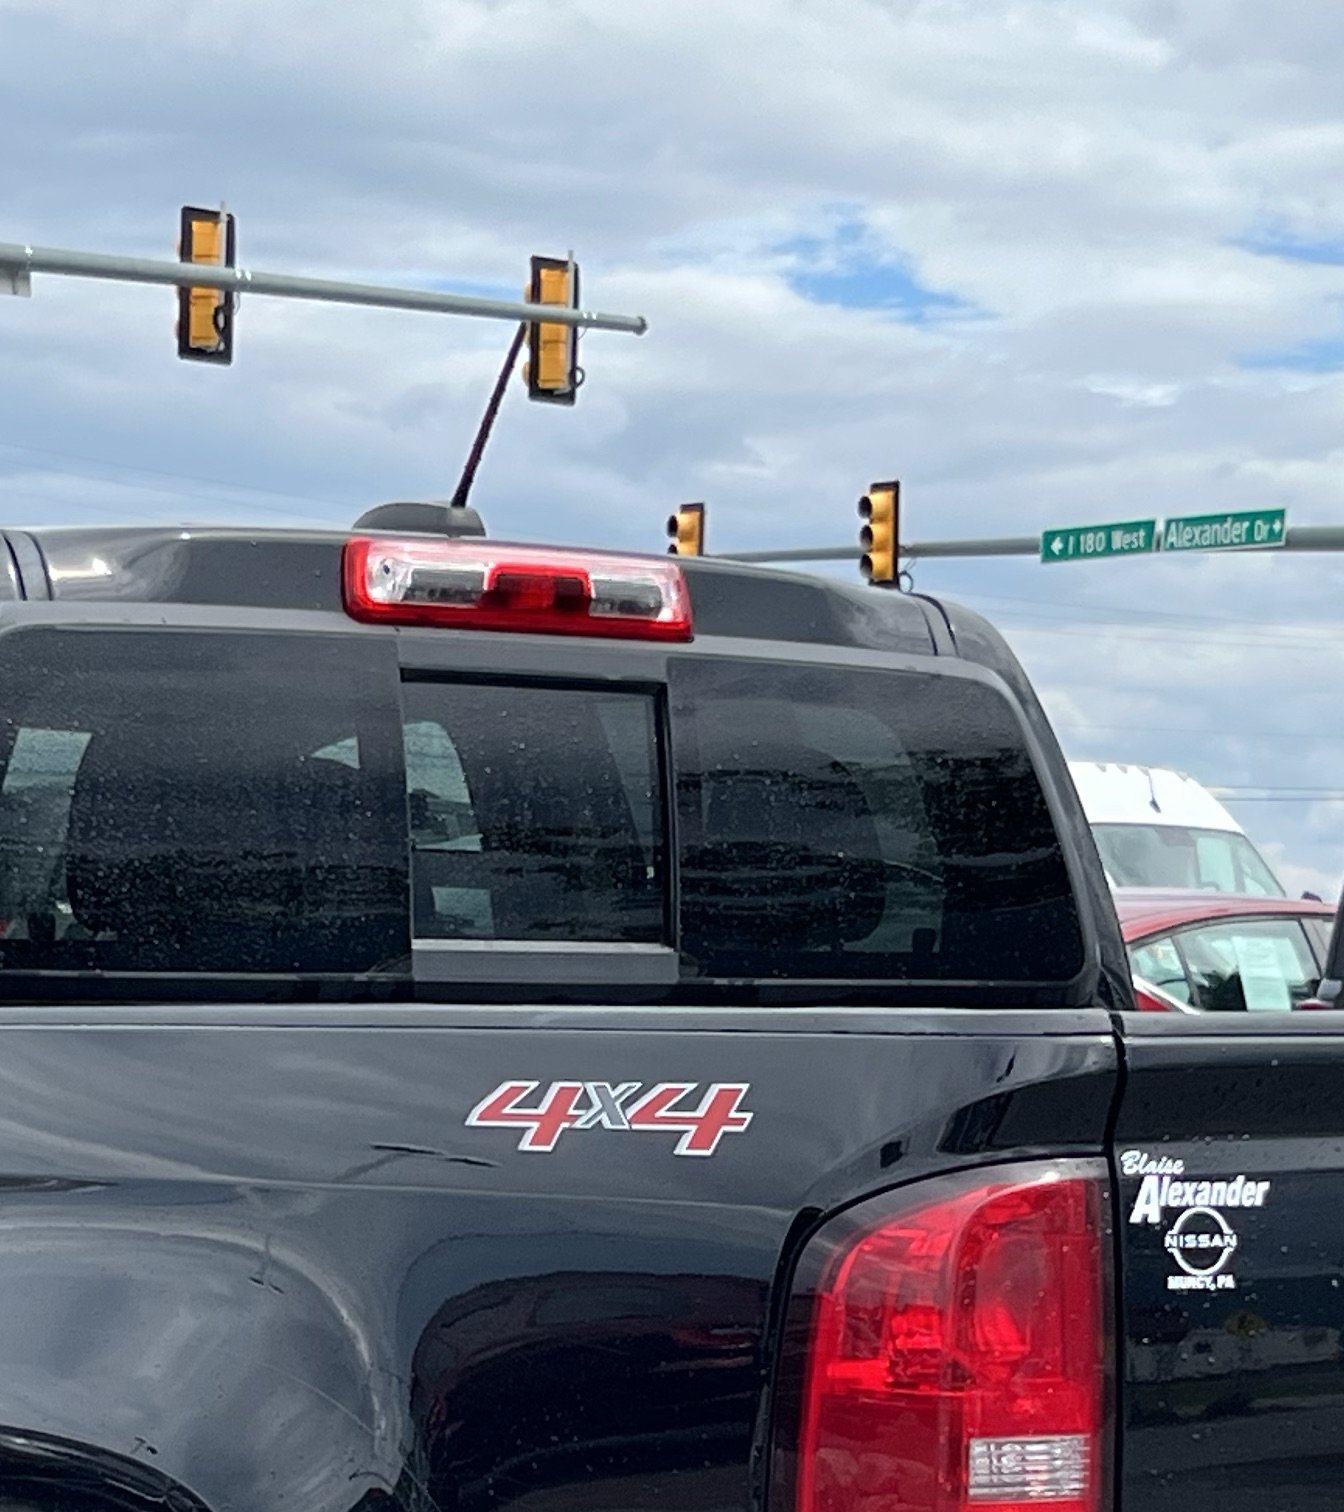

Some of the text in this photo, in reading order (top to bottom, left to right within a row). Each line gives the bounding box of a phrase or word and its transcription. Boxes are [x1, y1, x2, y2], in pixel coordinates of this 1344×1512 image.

[1080, 532, 1105, 553] 180
[1111, 527, 1146, 549] West
[1165, 517, 1270, 548] Alexander Dr
[1121, 1150, 1184, 1175] Blaise
[1129, 1175, 1270, 1223] Alexander
[1164, 1234, 1237, 1247] NISSAN
